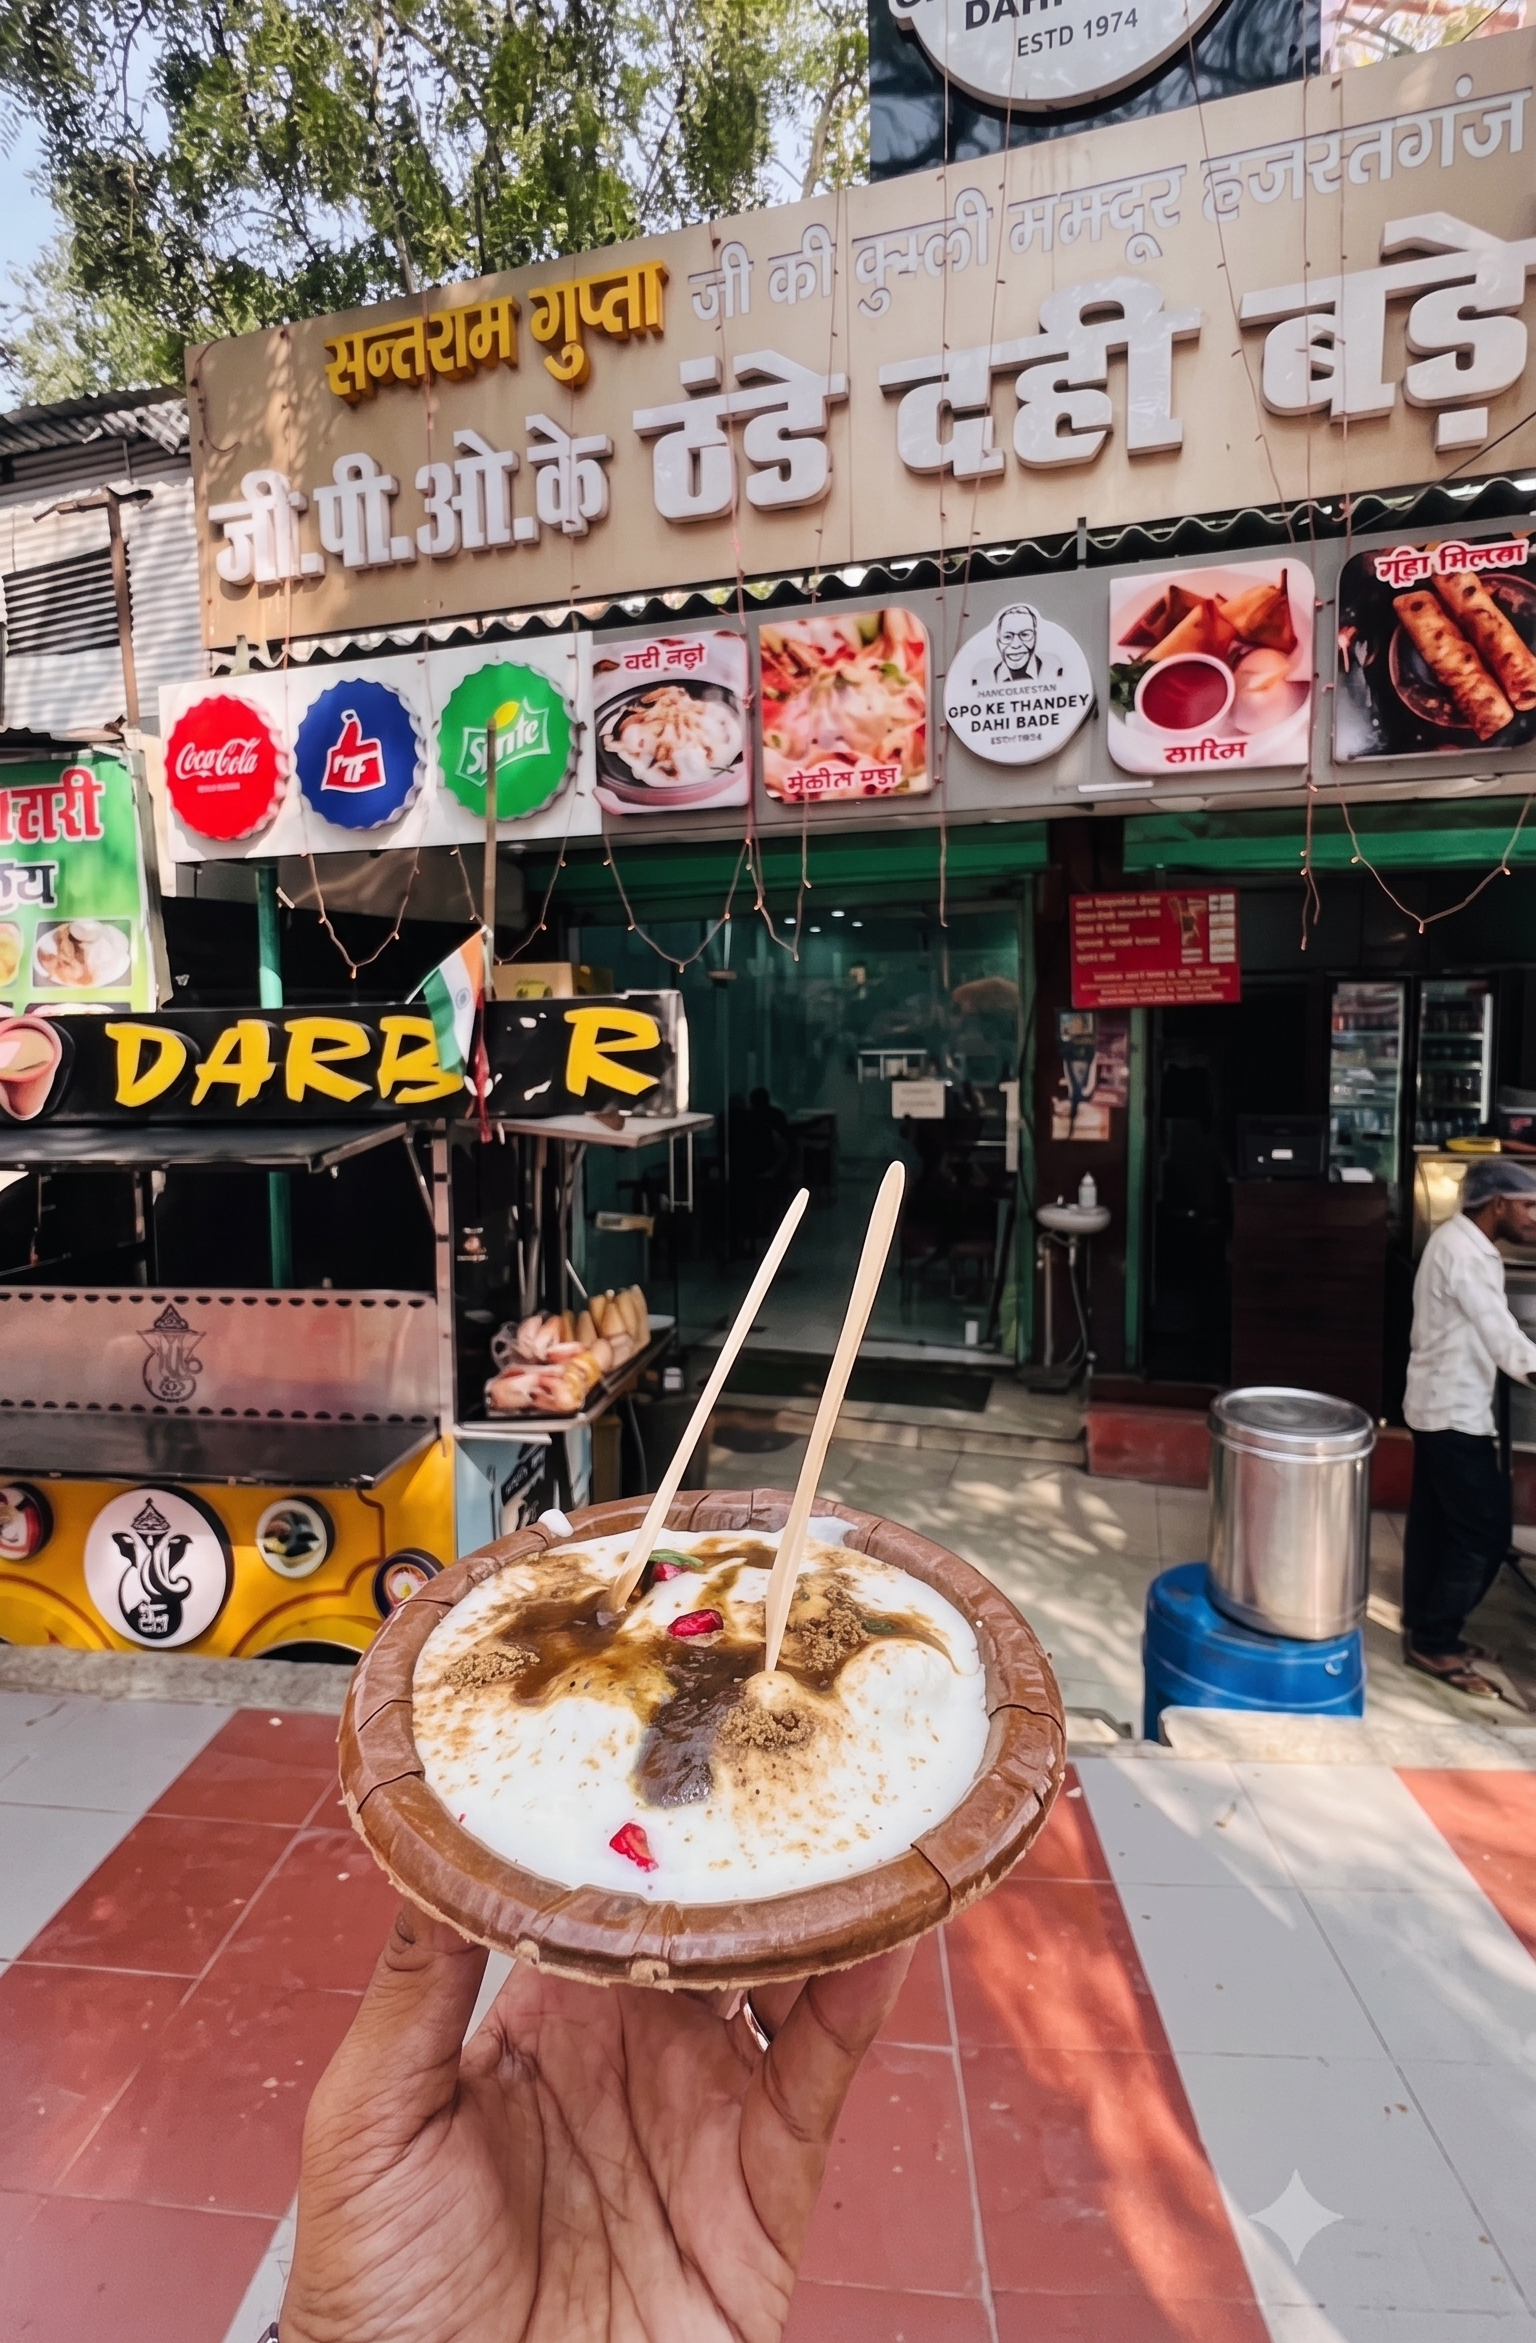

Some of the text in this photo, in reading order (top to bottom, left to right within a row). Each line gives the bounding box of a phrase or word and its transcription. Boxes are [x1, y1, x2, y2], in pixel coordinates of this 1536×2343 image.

[1016, 8, 1139, 58] ESTD 1974
[324, 297, 520, 401] सन्तराम
[528, 261, 669, 388] गुप्ता
[688, 241, 754, 321] जी
[767, 223, 837, 306] की
[1200, 73, 1534, 223] हजरतगंज
[632, 349, 849, 524] ठंडे
[879, 276, 1202, 481] दही
[971, 713, 1060, 733] DAHI BADE
[986, 702, 1005, 715] KE
[1010, 694, 1089, 713] THANDEY
